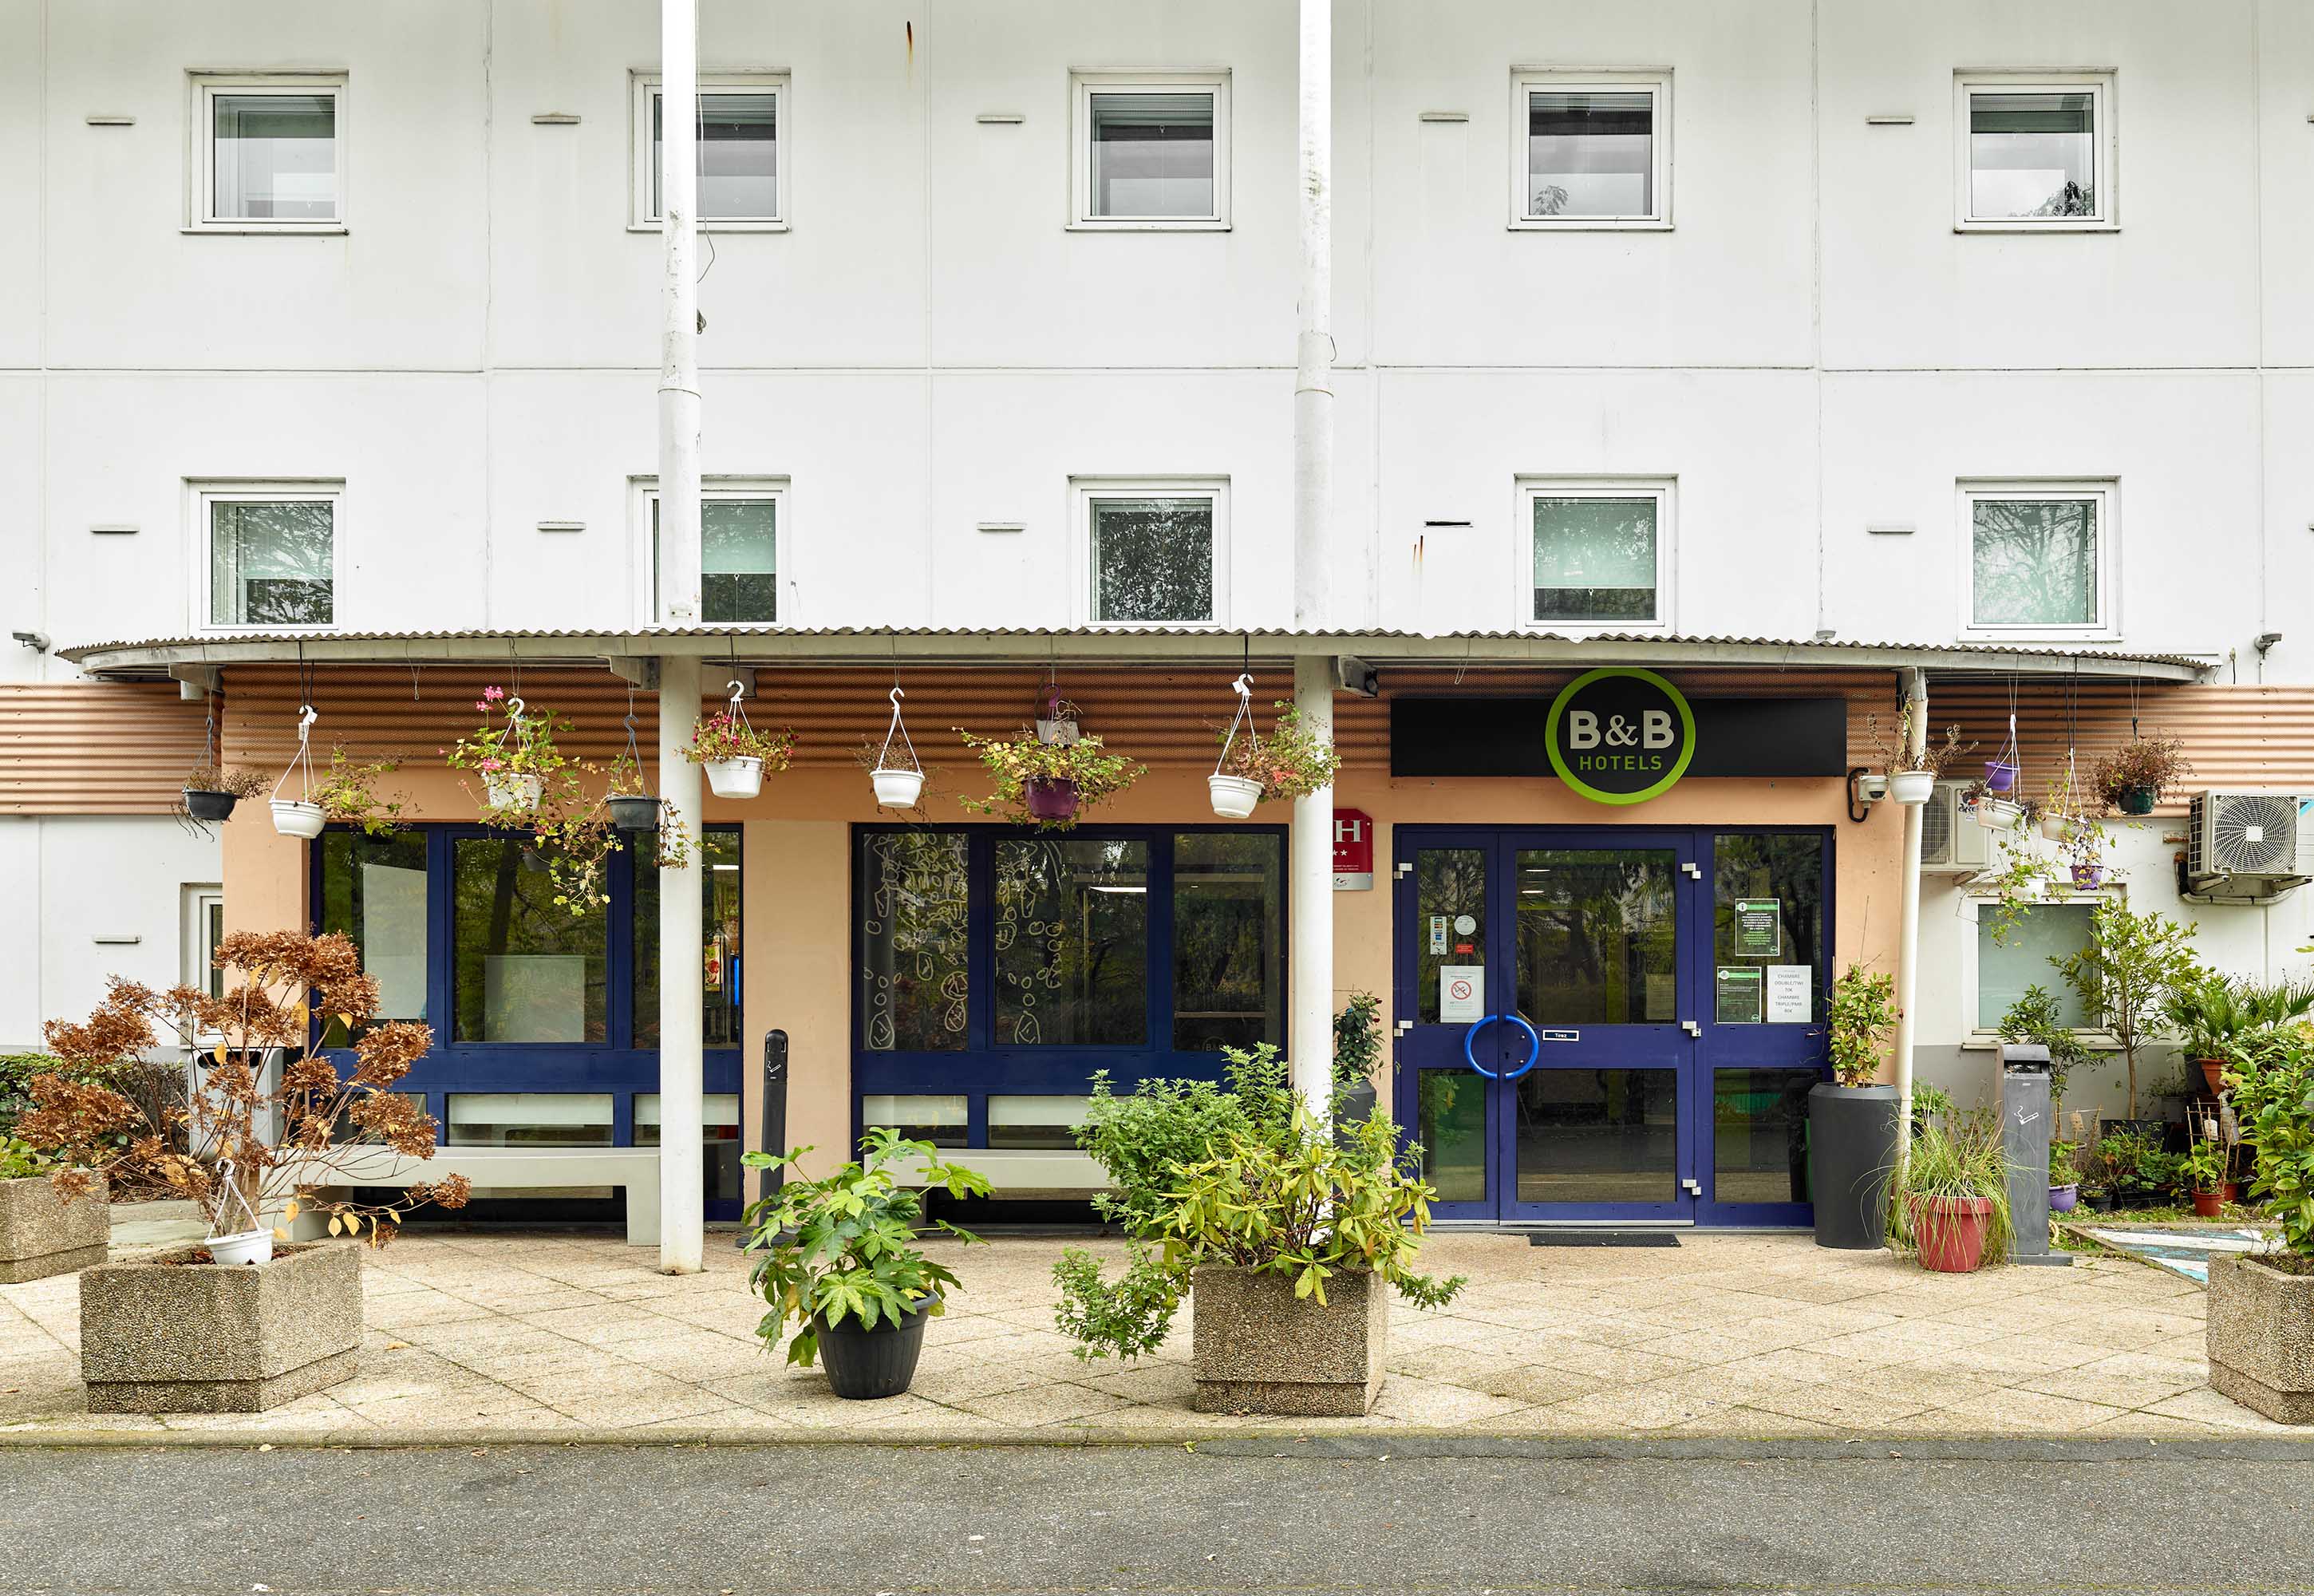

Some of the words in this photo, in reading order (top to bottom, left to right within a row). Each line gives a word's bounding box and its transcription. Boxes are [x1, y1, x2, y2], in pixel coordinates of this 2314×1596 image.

[1570, 710, 1675, 749] B&B
[1579, 756, 1662, 770] HOTELS
[1333, 820, 1364, 843] H
